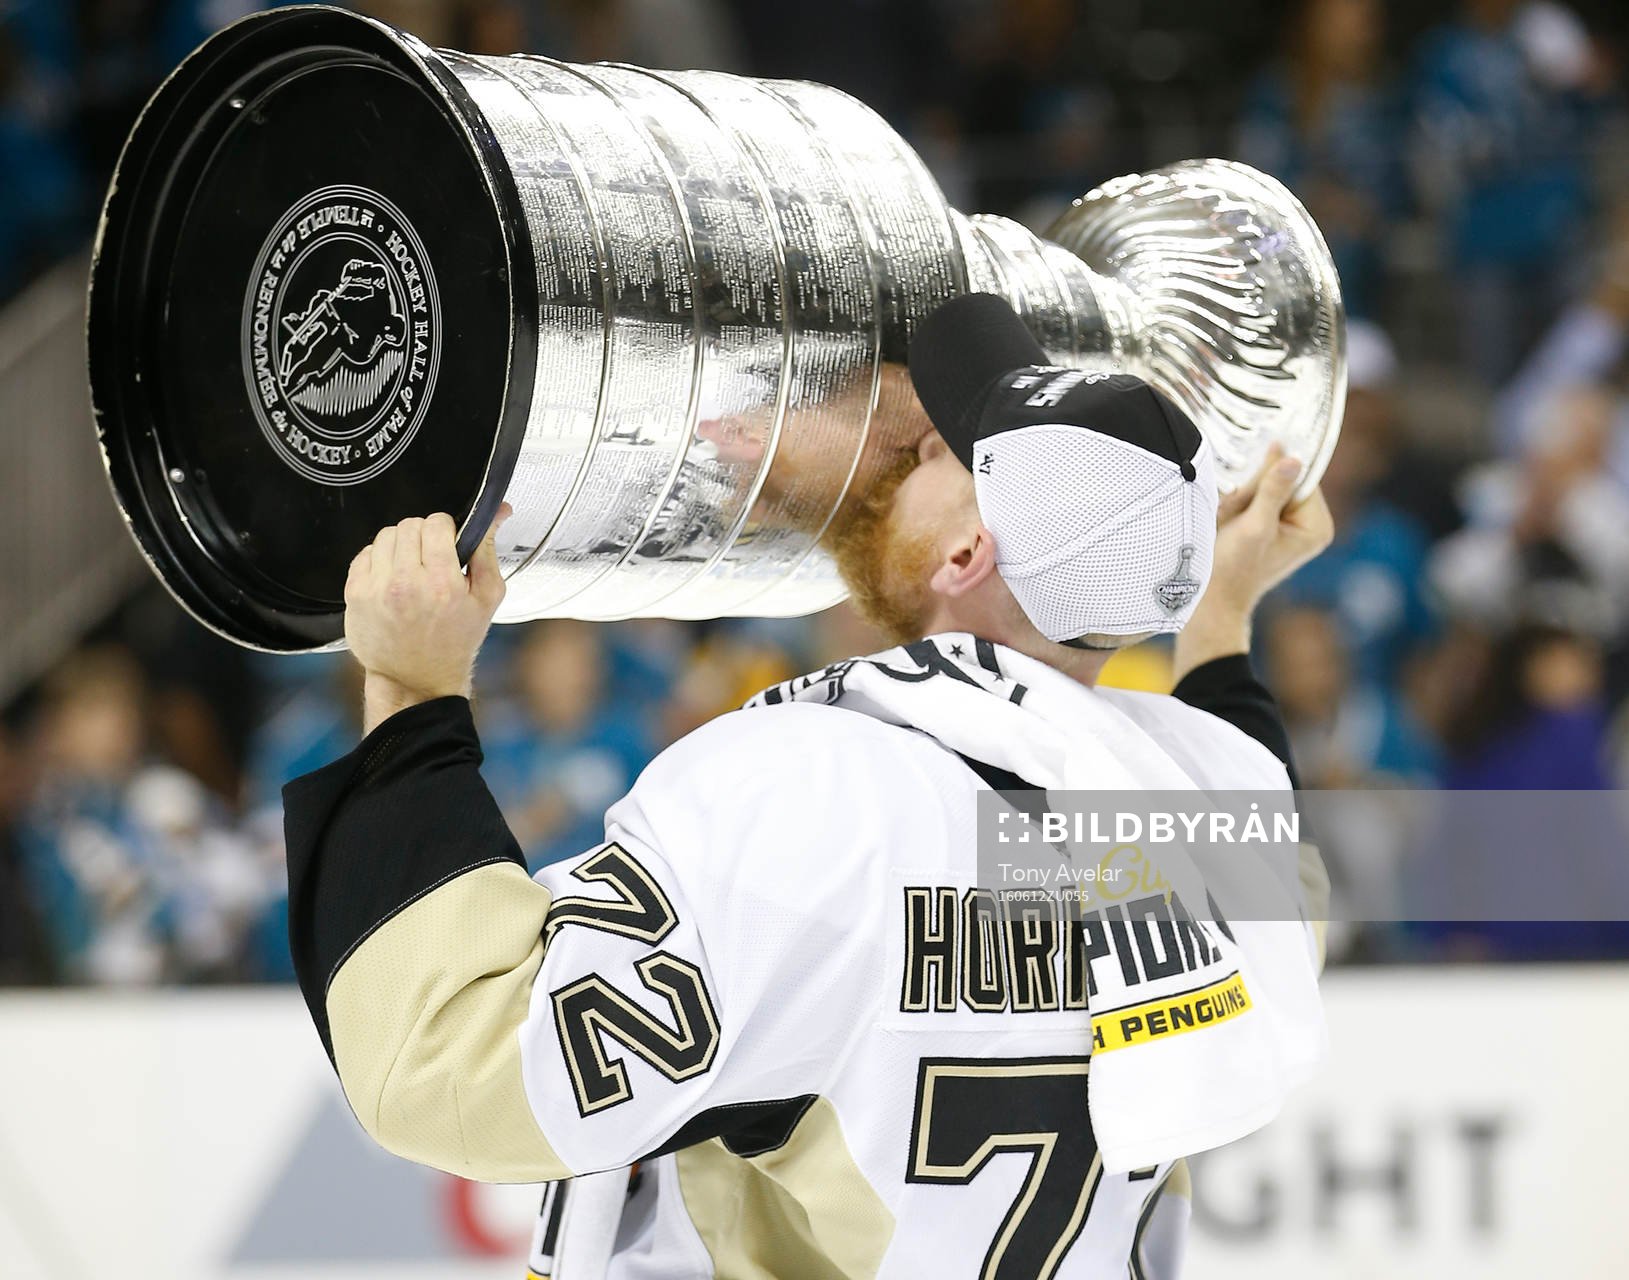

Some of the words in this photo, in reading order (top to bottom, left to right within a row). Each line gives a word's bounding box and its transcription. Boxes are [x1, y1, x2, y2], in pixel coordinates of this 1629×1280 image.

[281, 231, 297, 253] de
[296, 205, 360, 240] TEMPLE
[385, 230, 427, 313] HOCKEY
[409, 320, 429, 382] HALL
[400, 387, 413, 413] of
[286, 424, 352, 465] HOCKEY
[365, 407, 407, 457] FAME
[544, 841, 721, 1118] 72
